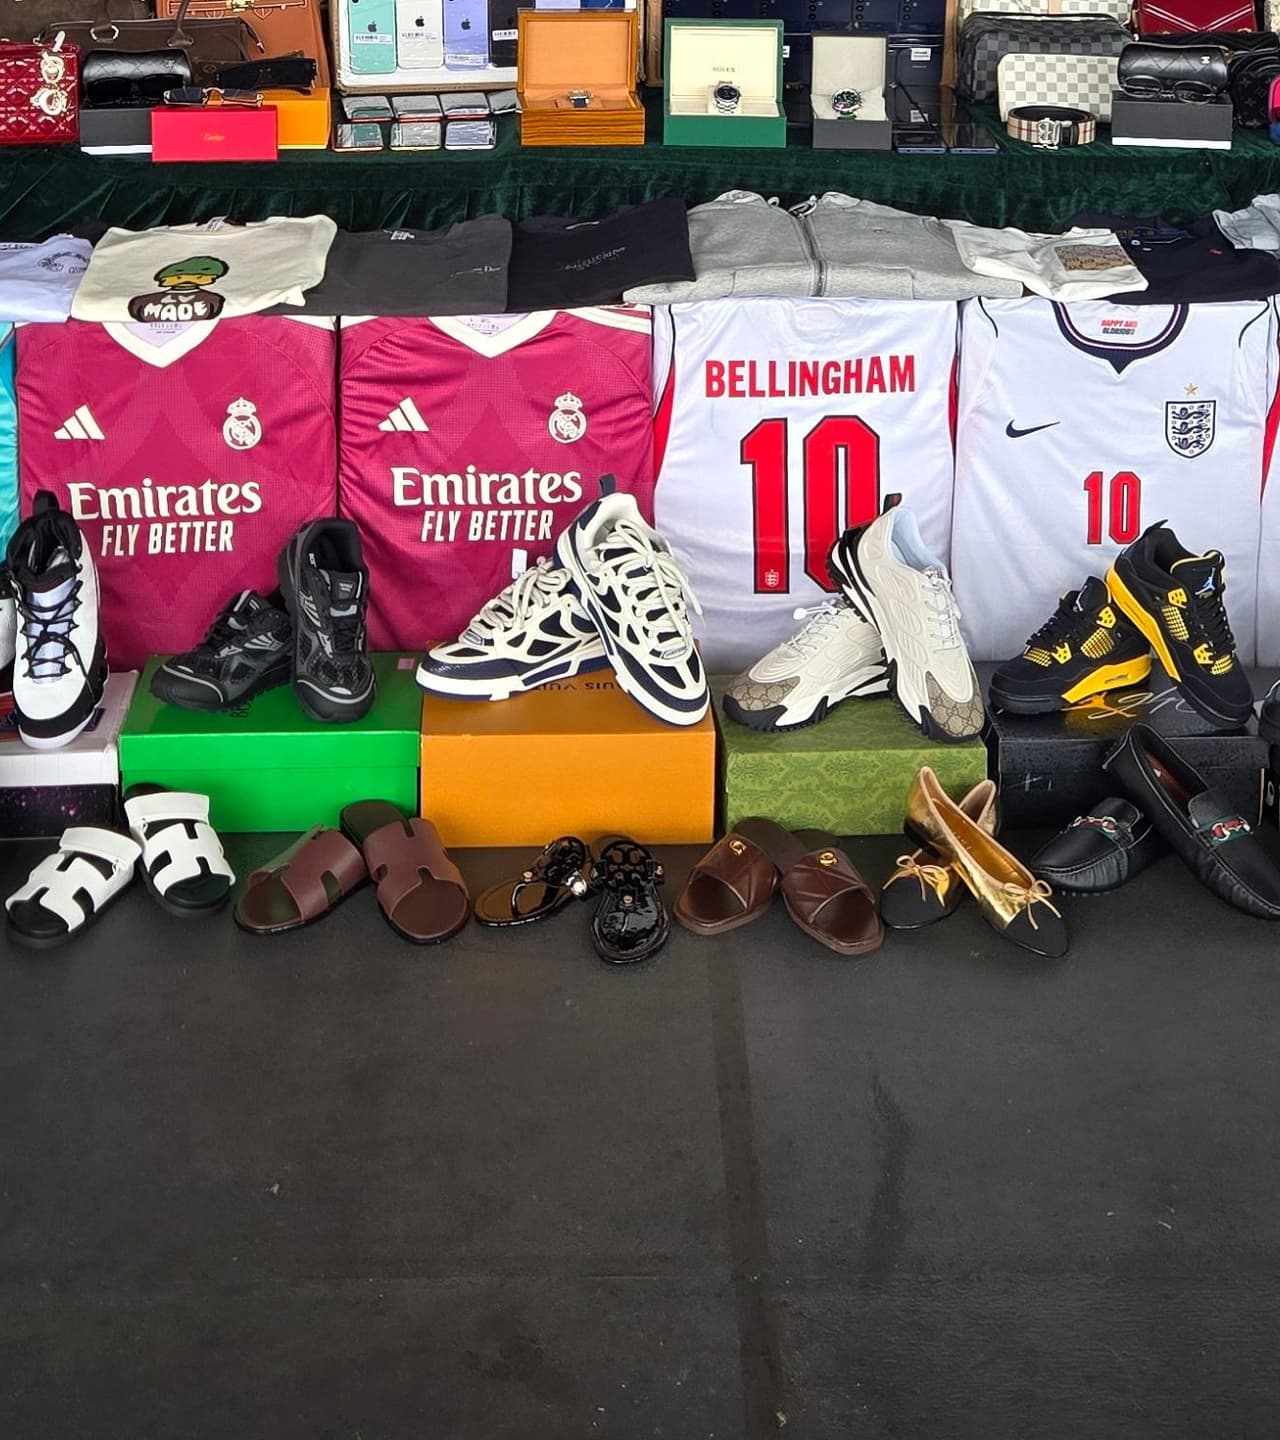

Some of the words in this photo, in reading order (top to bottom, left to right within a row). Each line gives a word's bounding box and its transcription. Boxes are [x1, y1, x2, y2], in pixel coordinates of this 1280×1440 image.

[143, 300, 208, 322] MADE
[705, 355, 916, 398] BELLINGHAM
[66, 478, 262, 521] Emirates
[389, 465, 583, 508] Emirates
[739, 414, 881, 596] 10
[1082, 471, 1141, 545] 10
[101, 524, 144, 557] FLY
[148, 519, 235, 554] BETTER
[421, 510, 461, 543] FLY
[464, 507, 553, 542] BETTER
